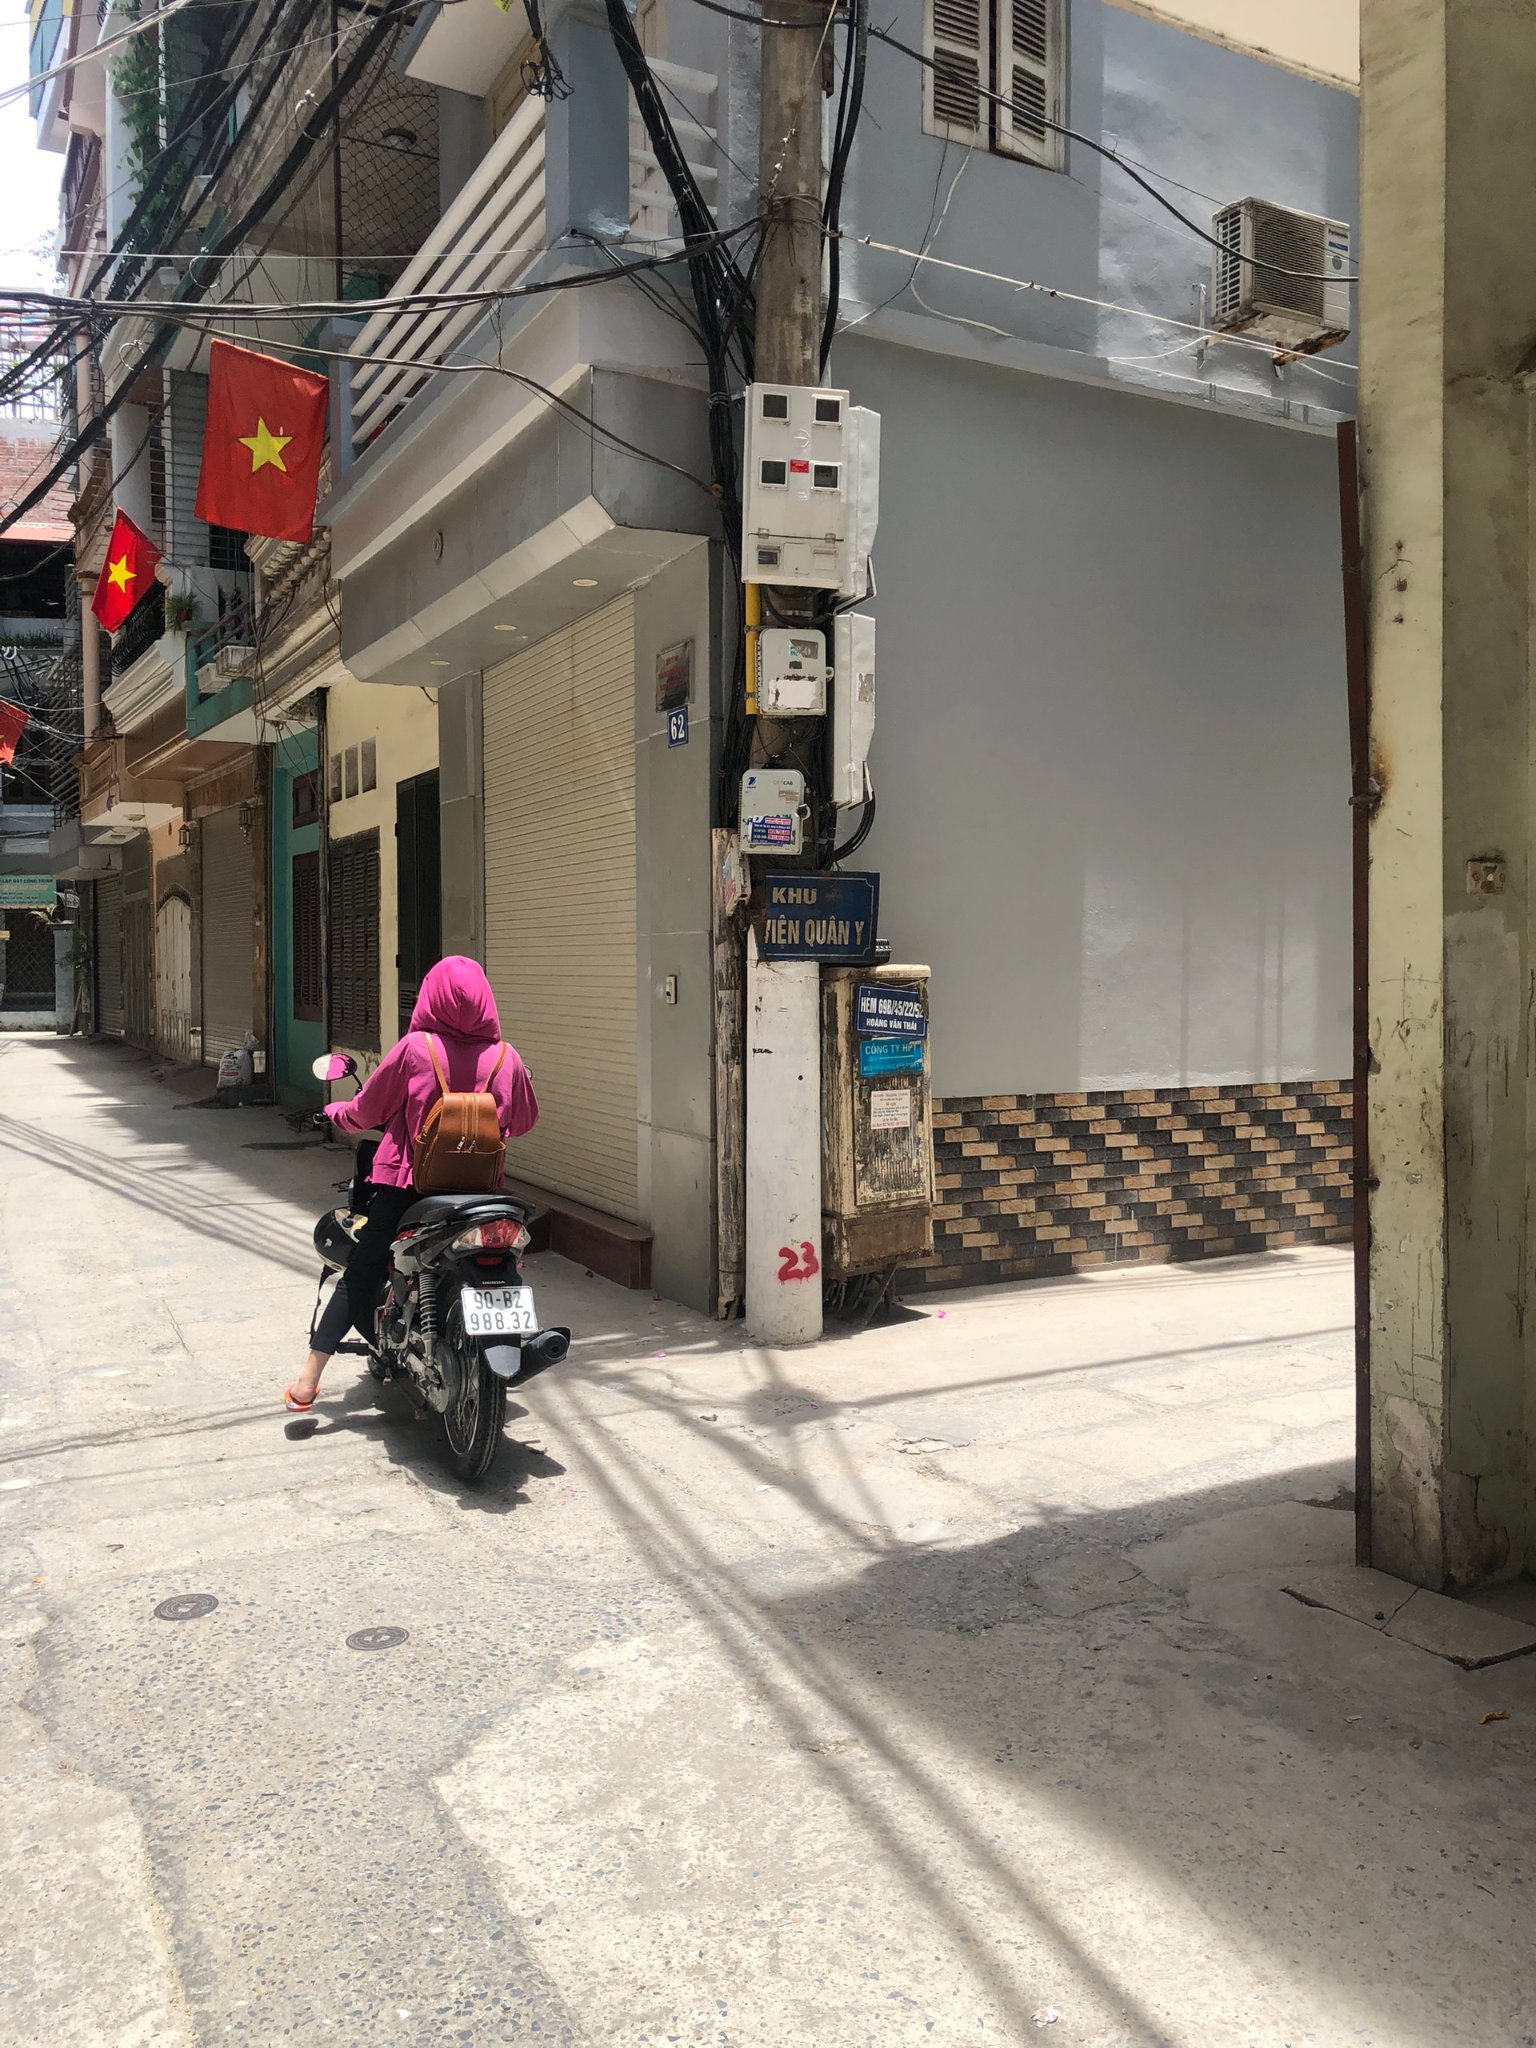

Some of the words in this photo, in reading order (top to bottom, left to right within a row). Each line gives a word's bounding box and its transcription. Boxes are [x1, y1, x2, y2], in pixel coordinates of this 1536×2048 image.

[670, 714, 685, 740] 62
[772, 887, 817, 905] KHU
[804, 915, 850, 947] QUÂN
[855, 920, 865, 945] Y
[860, 990, 877, 1014] HẺM
[866, 1016, 888, 1028] HOÀNG
[889, 1018, 902, 1029] VĂN
[903, 1019, 917, 1031] THÁI
[865, 1042, 888, 1055] CÔNG
[890, 1044, 900, 1053] TY
[778, 1241, 819, 1281] 23
[474, 1290, 523, 1310] 90-B2
[470, 1310, 531, 1331] 988.32
